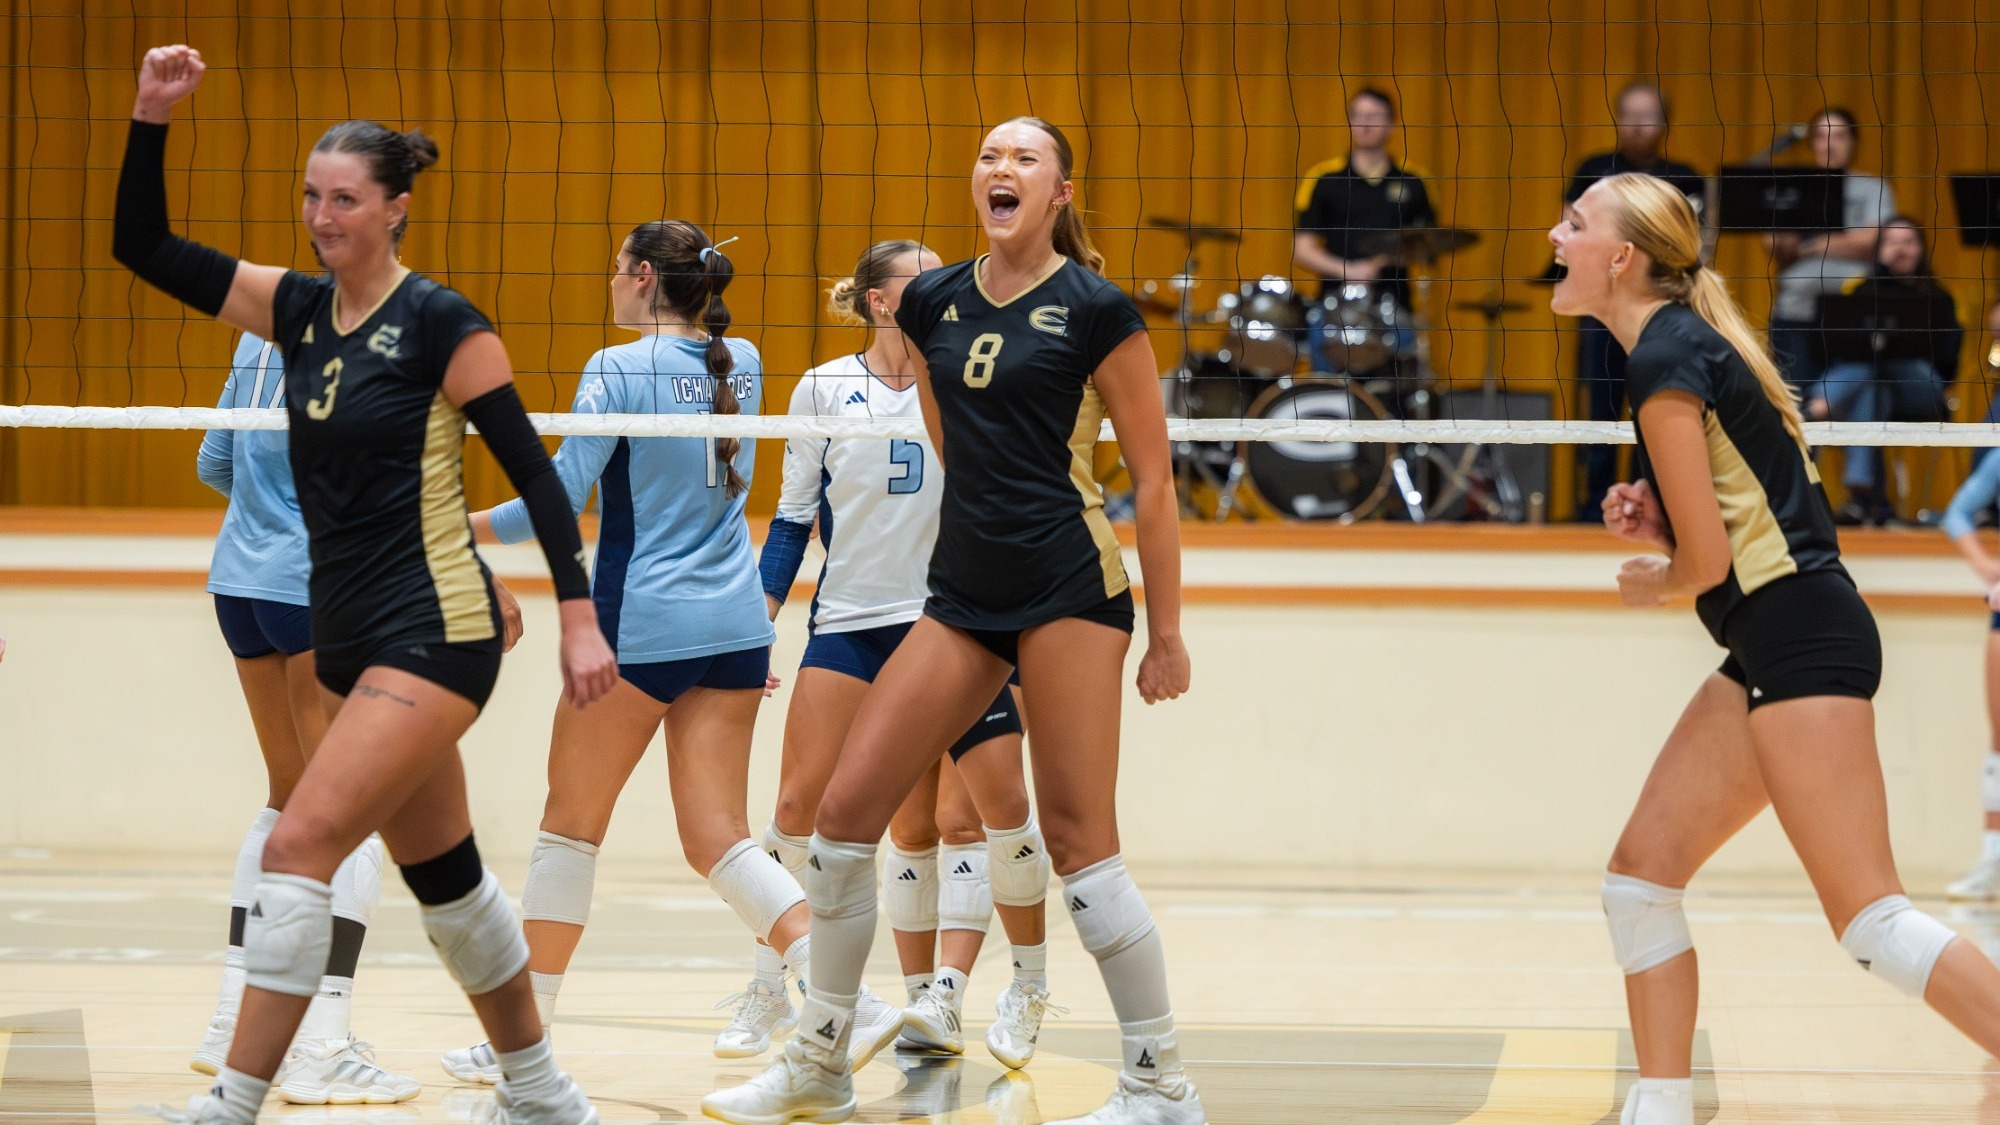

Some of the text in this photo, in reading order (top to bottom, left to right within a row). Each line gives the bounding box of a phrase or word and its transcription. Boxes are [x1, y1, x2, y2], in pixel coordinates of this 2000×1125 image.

[306, 356, 344, 420] 3
[963, 333, 1004, 389] 8
[888, 438, 924, 494] 5
